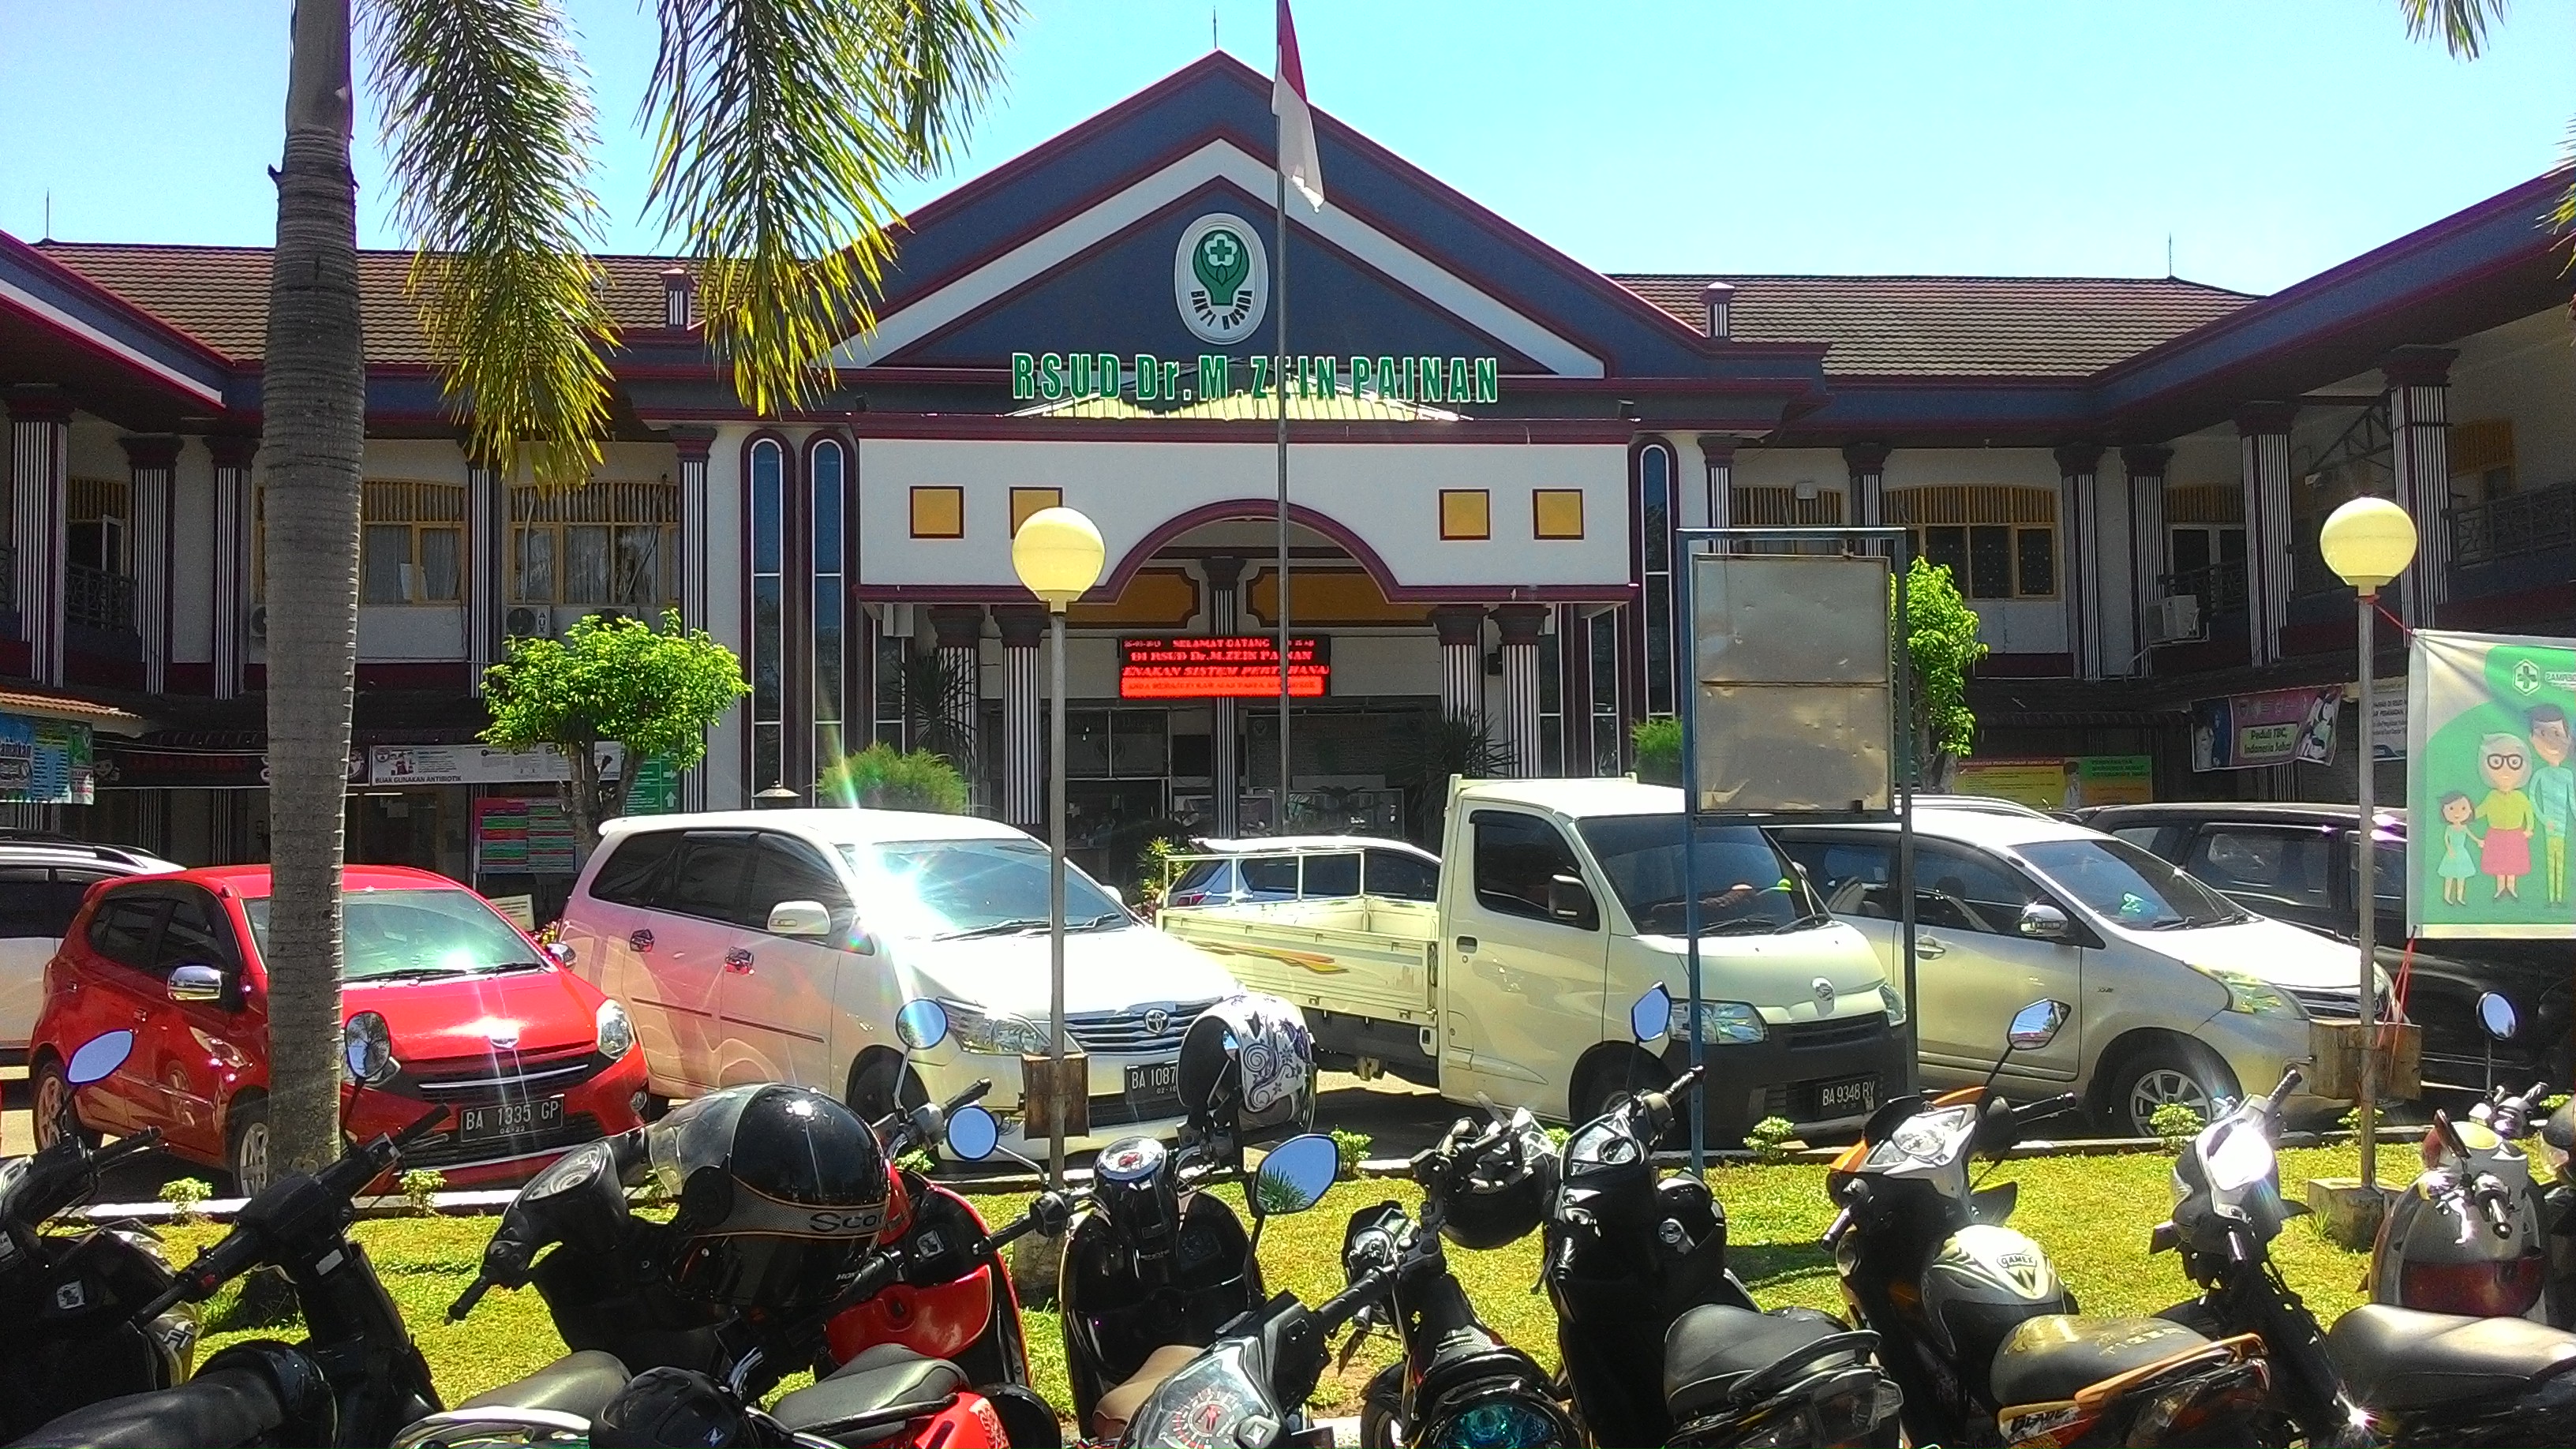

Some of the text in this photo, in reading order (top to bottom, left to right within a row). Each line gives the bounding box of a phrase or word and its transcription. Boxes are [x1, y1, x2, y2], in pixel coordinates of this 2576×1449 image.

[1190, 290, 1253, 331] BAKTI HUSADA
[1012, 353, 1121, 400] RSUD
[1350, 356, 1497, 403] PAINAN
[1173, 639, 1223, 648] SELAMAT
[1225, 638, 1270, 648] DATANG
[1131, 652, 1148, 661] DI
[1151, 652, 1187, 661] RSUD
[1260, 650, 1312, 661] PANAN
[1184, 666, 1239, 676] SISTEM
[1131, 1066, 1177, 1089] BA 1087
[1822, 1088, 1835, 1106] BA
[1837, 1083, 1860, 1103] 9348
[466, 1101, 559, 1130] BA 1335 GP
[499, 1125, 526, 1134] 04-22
